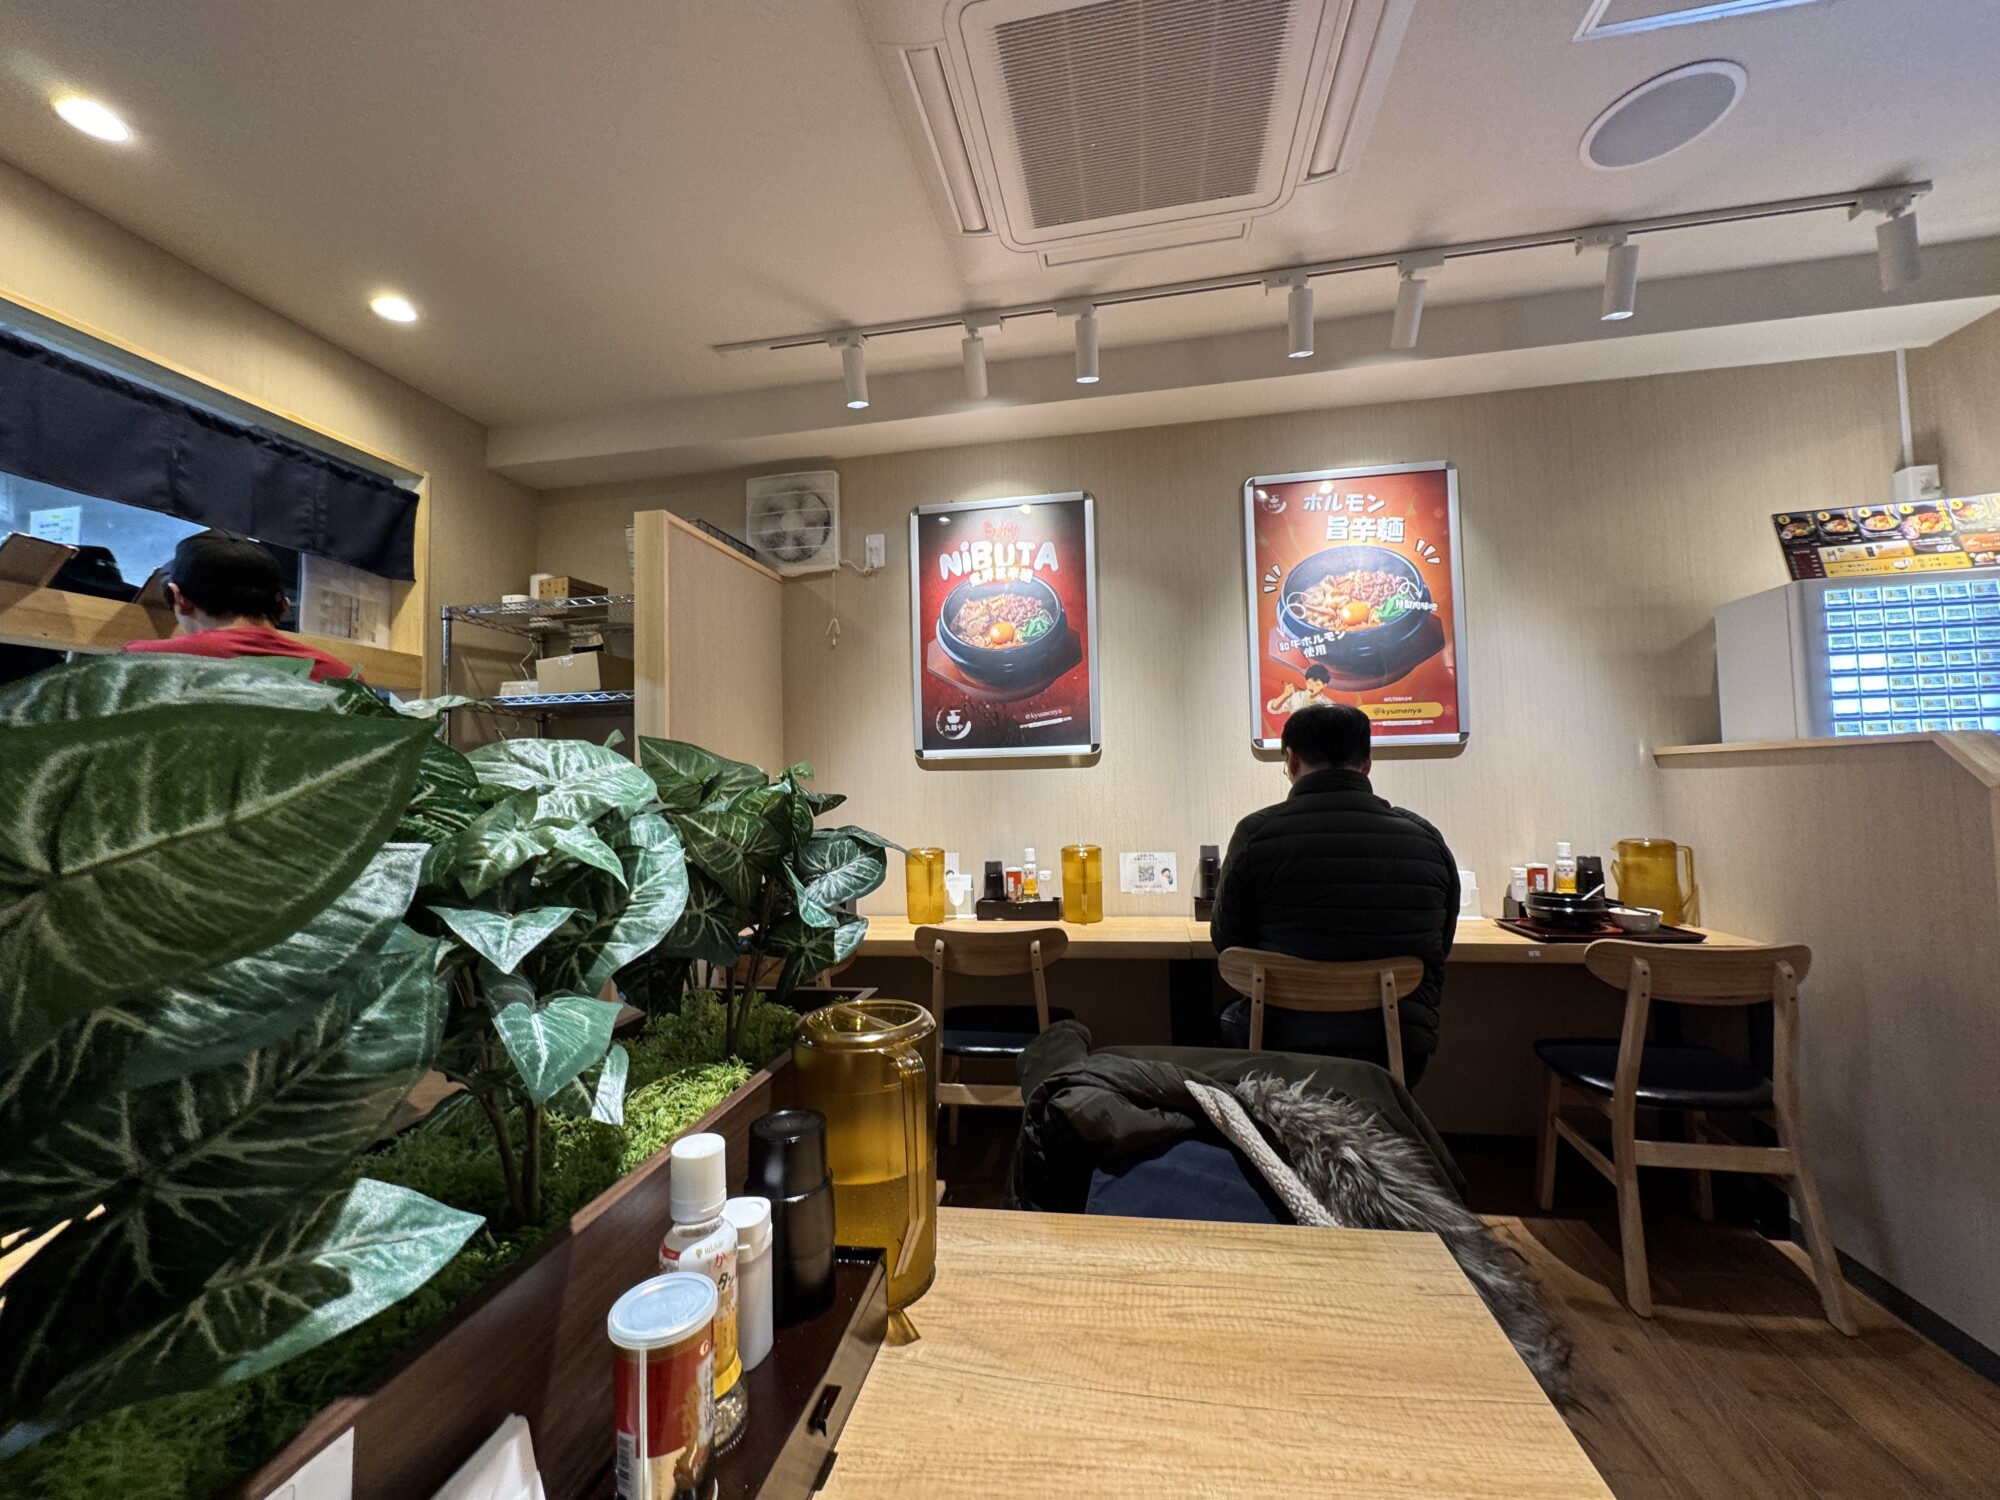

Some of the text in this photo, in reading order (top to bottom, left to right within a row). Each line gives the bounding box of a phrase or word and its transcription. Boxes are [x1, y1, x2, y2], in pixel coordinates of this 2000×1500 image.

[1303, 492, 1386, 513] ホルモン
[1325, 515, 1405, 543] 旨辛麺
[1278, 630, 1346, 652] 和牛ホルモン
[1303, 645, 1327, 659] 使用
[1024, 708, 1063, 720] @kyumenya
[1373, 706, 1422, 716] @kyumenya
